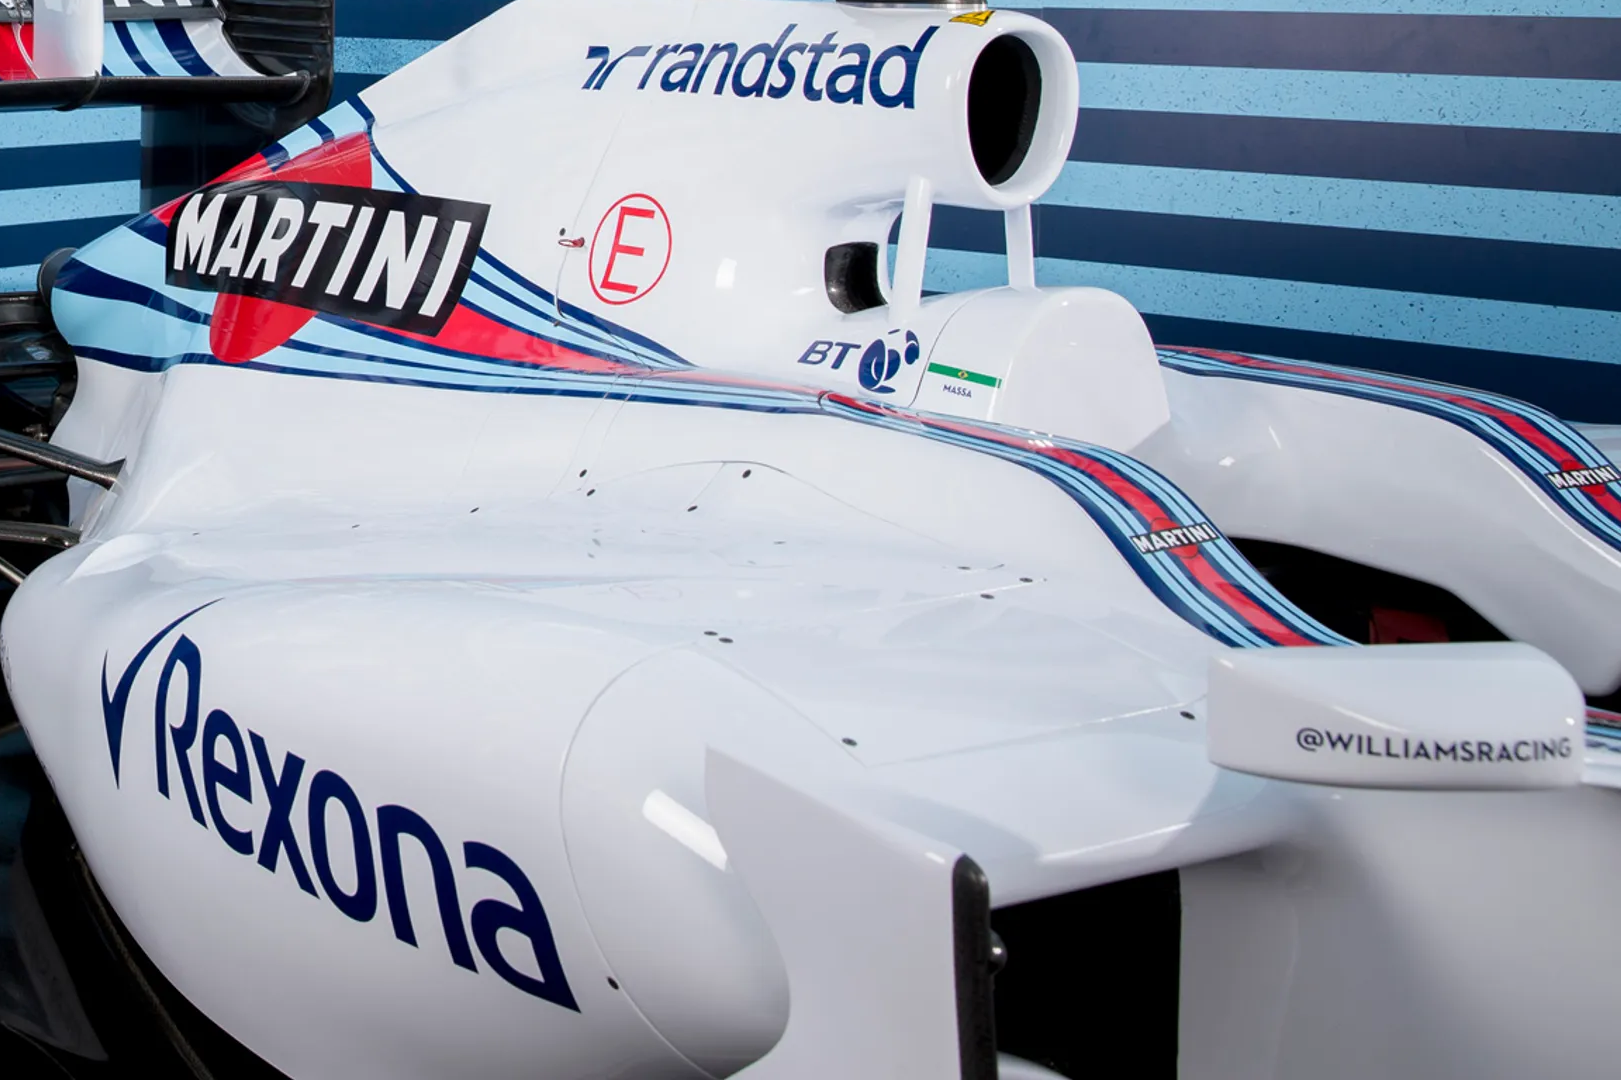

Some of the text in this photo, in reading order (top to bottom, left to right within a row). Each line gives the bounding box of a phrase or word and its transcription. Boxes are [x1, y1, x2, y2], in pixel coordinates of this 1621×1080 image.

[638, 24, 939, 110] randstad
[174, 192, 472, 318] MARTINI
[600, 208, 656, 295] E
[797, 340, 861, 370] BT
[943, 384, 972, 399] MASSA
[1548, 466, 1620, 490] MARTINI
[1135, 524, 1217, 554] MARTINI
[1296, 726, 1572, 763] @WILLIAMSRACING
[154, 633, 581, 1013] Rexona
